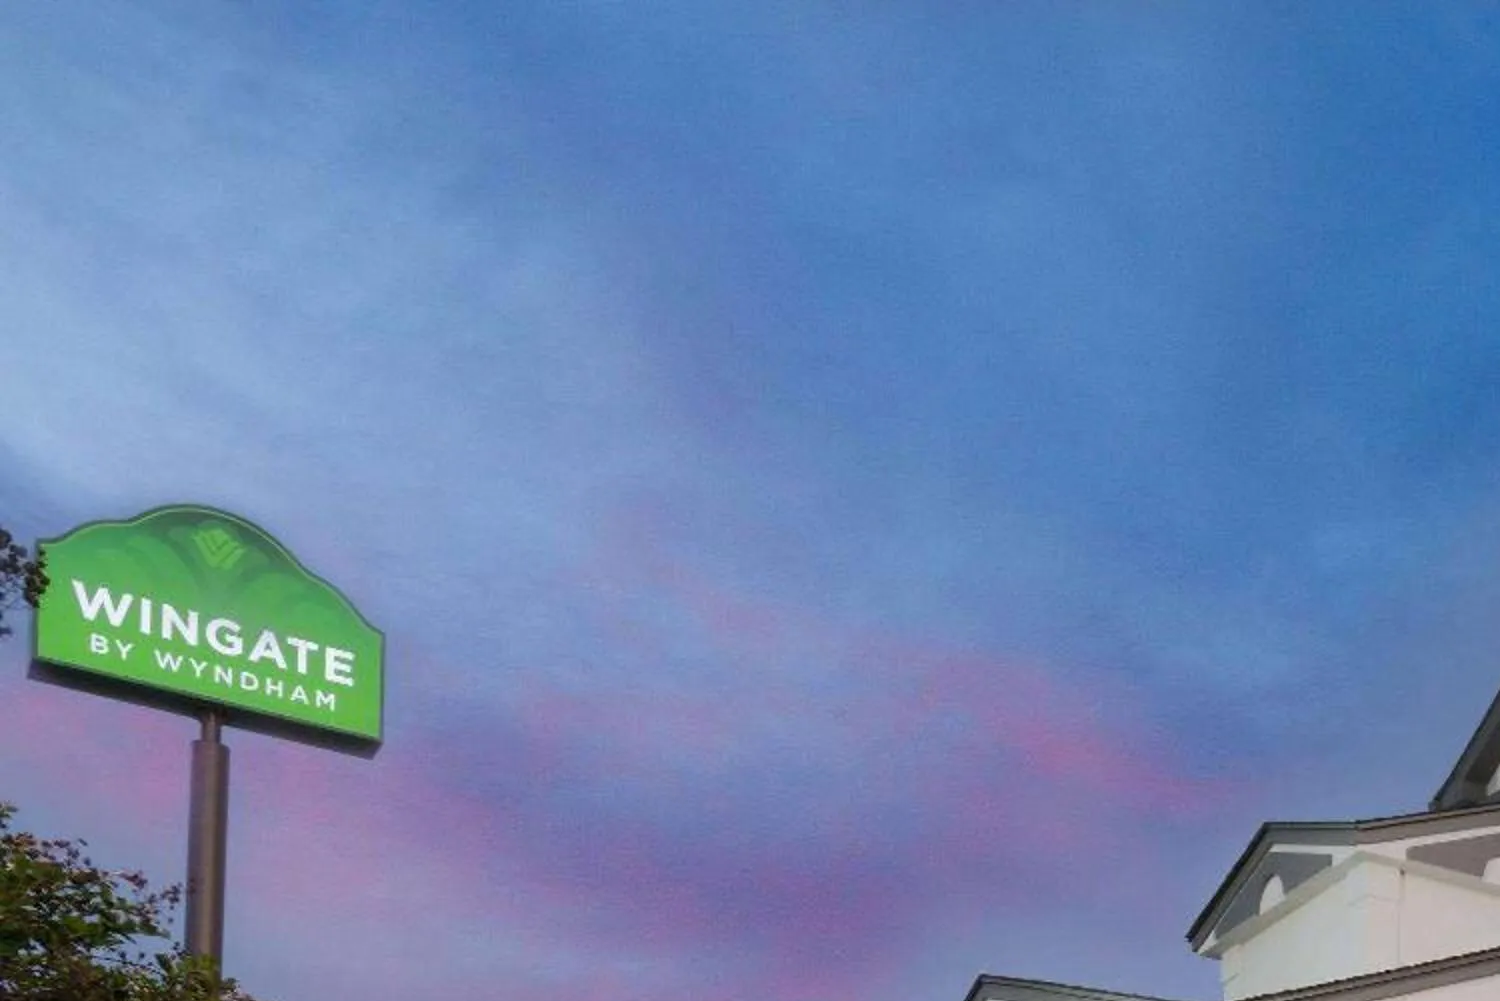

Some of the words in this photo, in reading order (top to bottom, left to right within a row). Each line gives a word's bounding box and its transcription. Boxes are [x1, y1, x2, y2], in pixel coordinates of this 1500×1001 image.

[71, 578, 356, 687] WINGATE
[89, 632, 135, 660] BY
[154, 649, 336, 712] WYNDHAM
